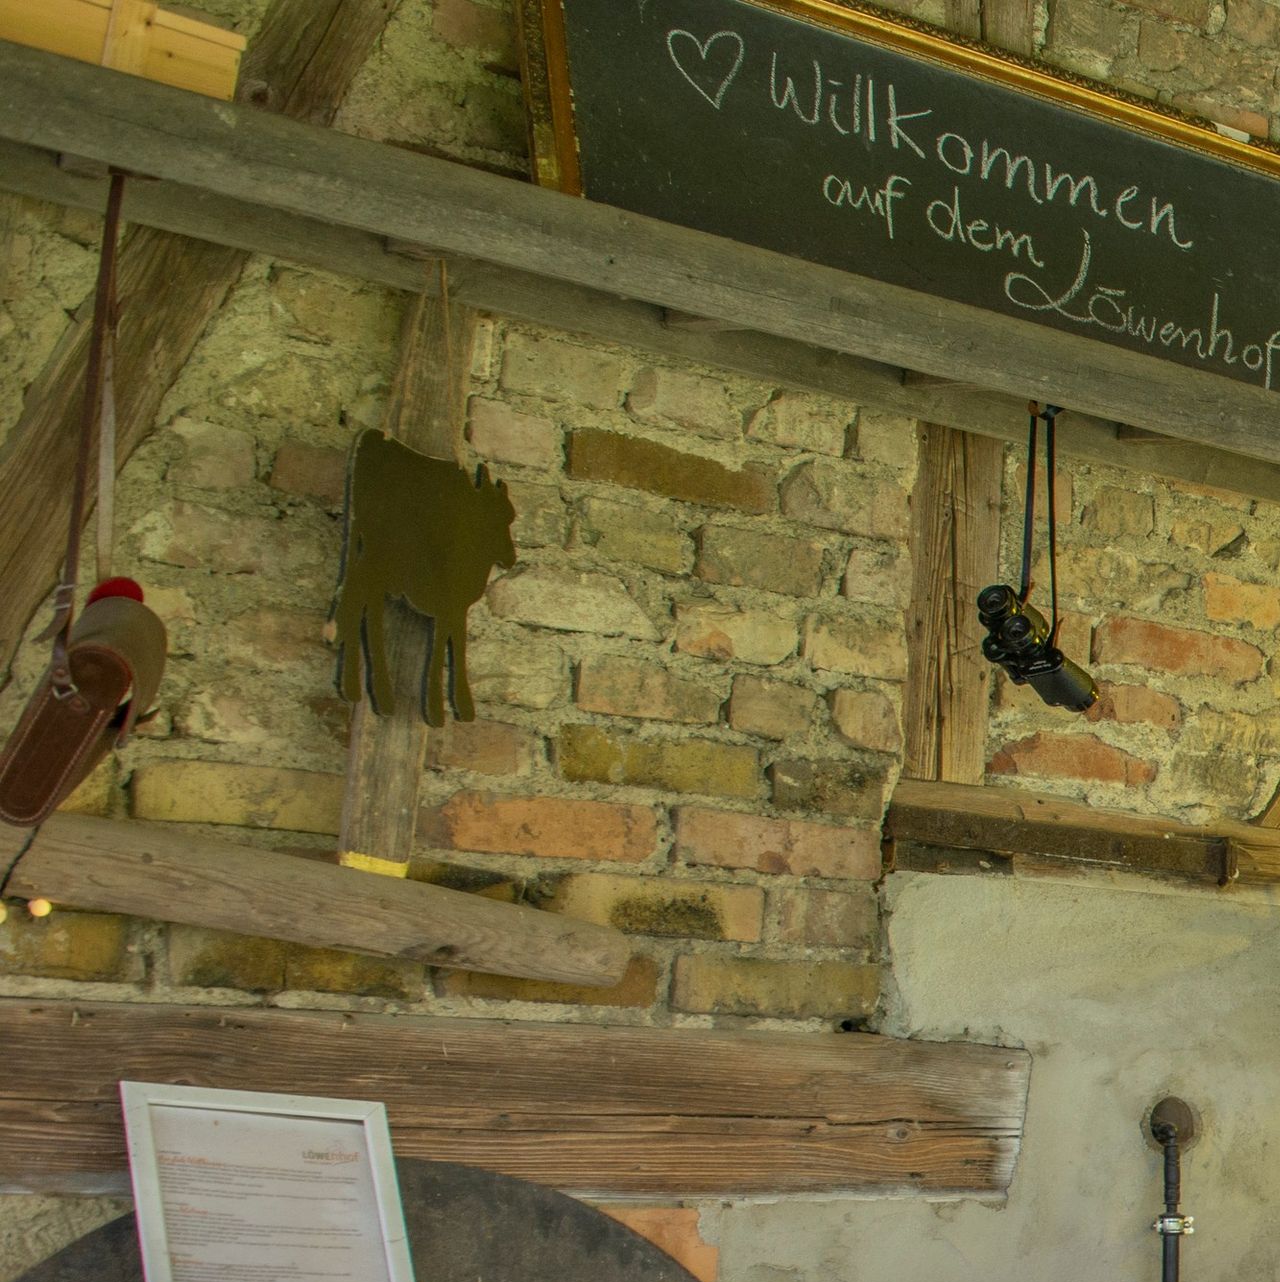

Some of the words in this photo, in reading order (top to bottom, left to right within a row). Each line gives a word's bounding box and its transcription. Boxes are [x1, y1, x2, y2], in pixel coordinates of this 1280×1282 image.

[770, 51, 1194, 249] Willkommen
[822, 174, 912, 239] auf
[926, 185, 1044, 268] dem
